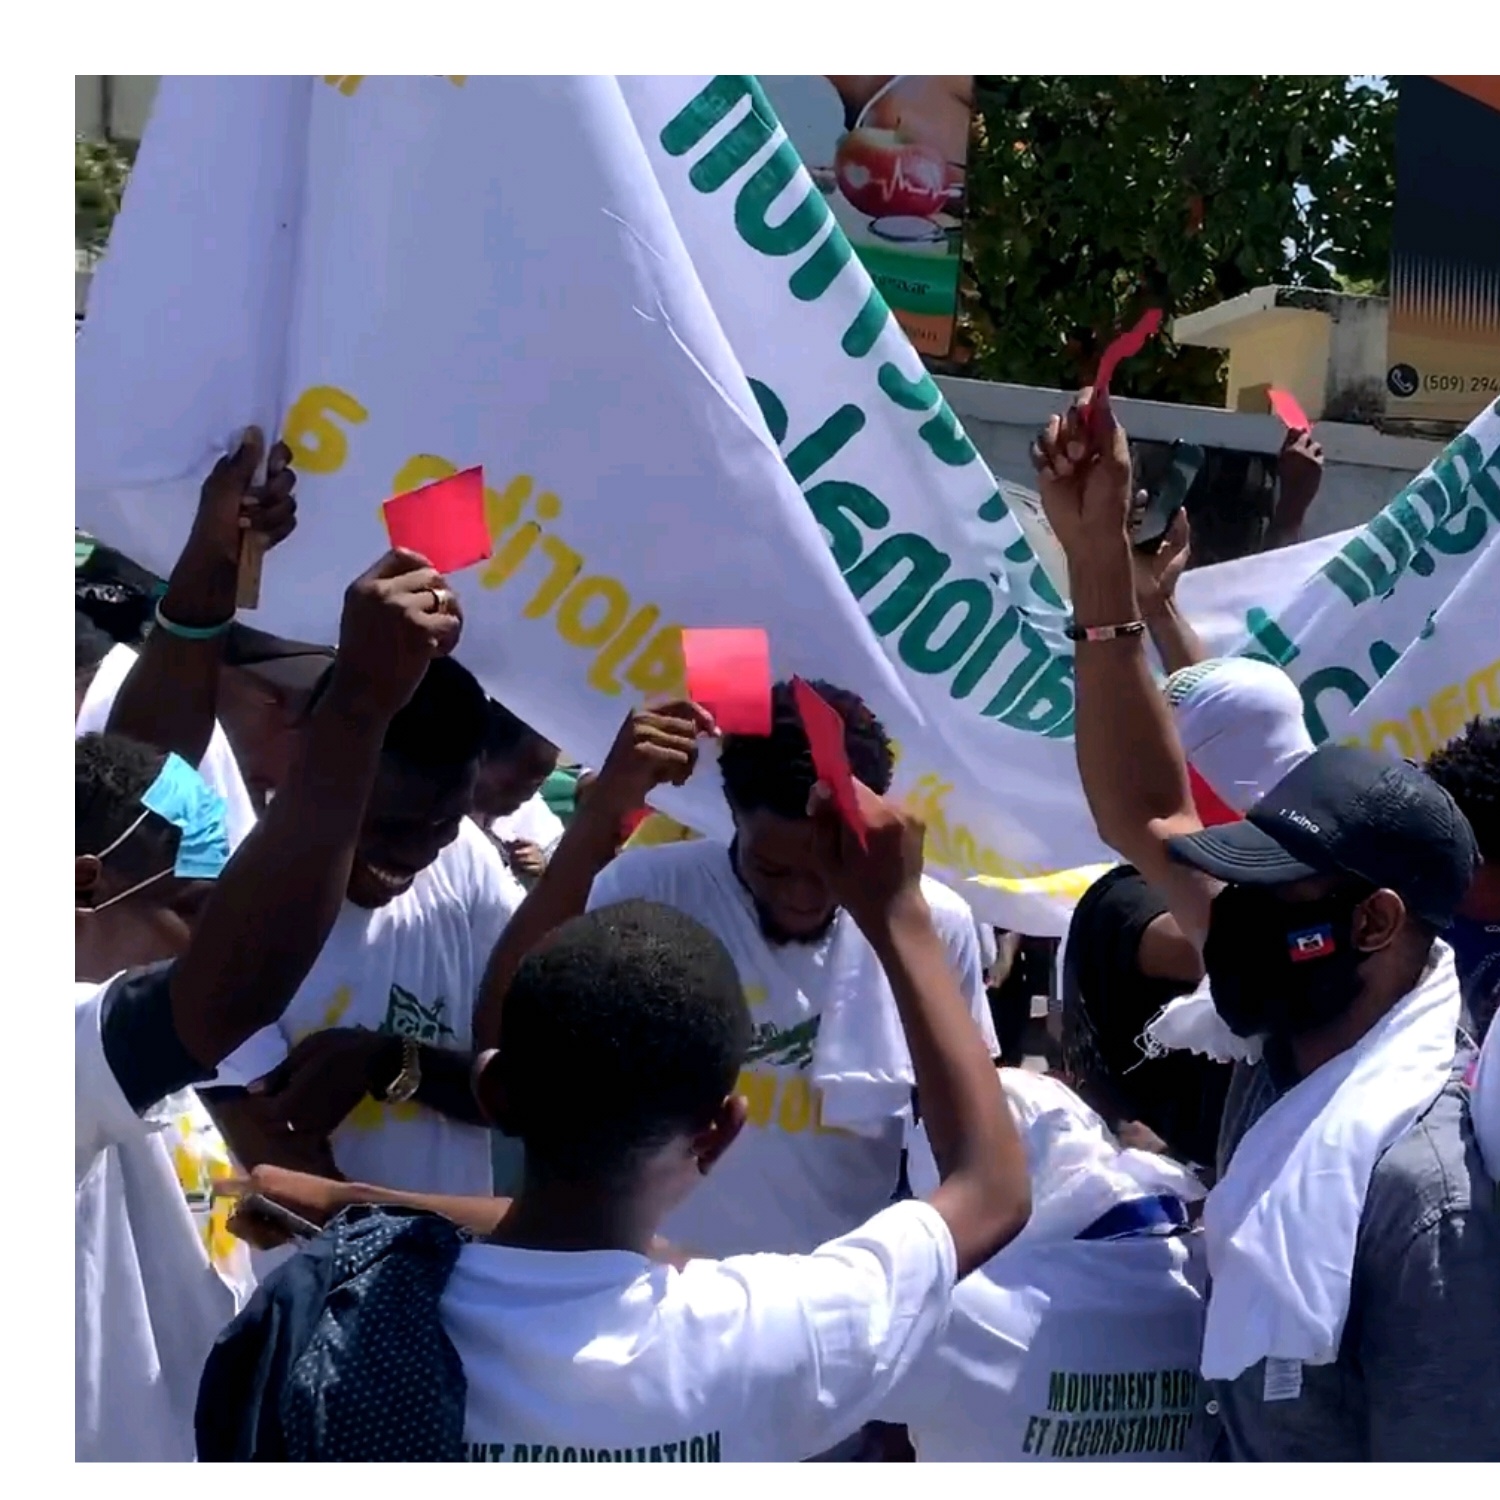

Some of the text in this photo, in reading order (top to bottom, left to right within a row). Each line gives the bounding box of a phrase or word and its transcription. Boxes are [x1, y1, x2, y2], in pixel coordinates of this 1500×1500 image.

[1423, 374, 1464, 393] (509)
[1048, 1371, 1158, 1413] MOUVEMENT
[1022, 1415, 1051, 1455] ET
